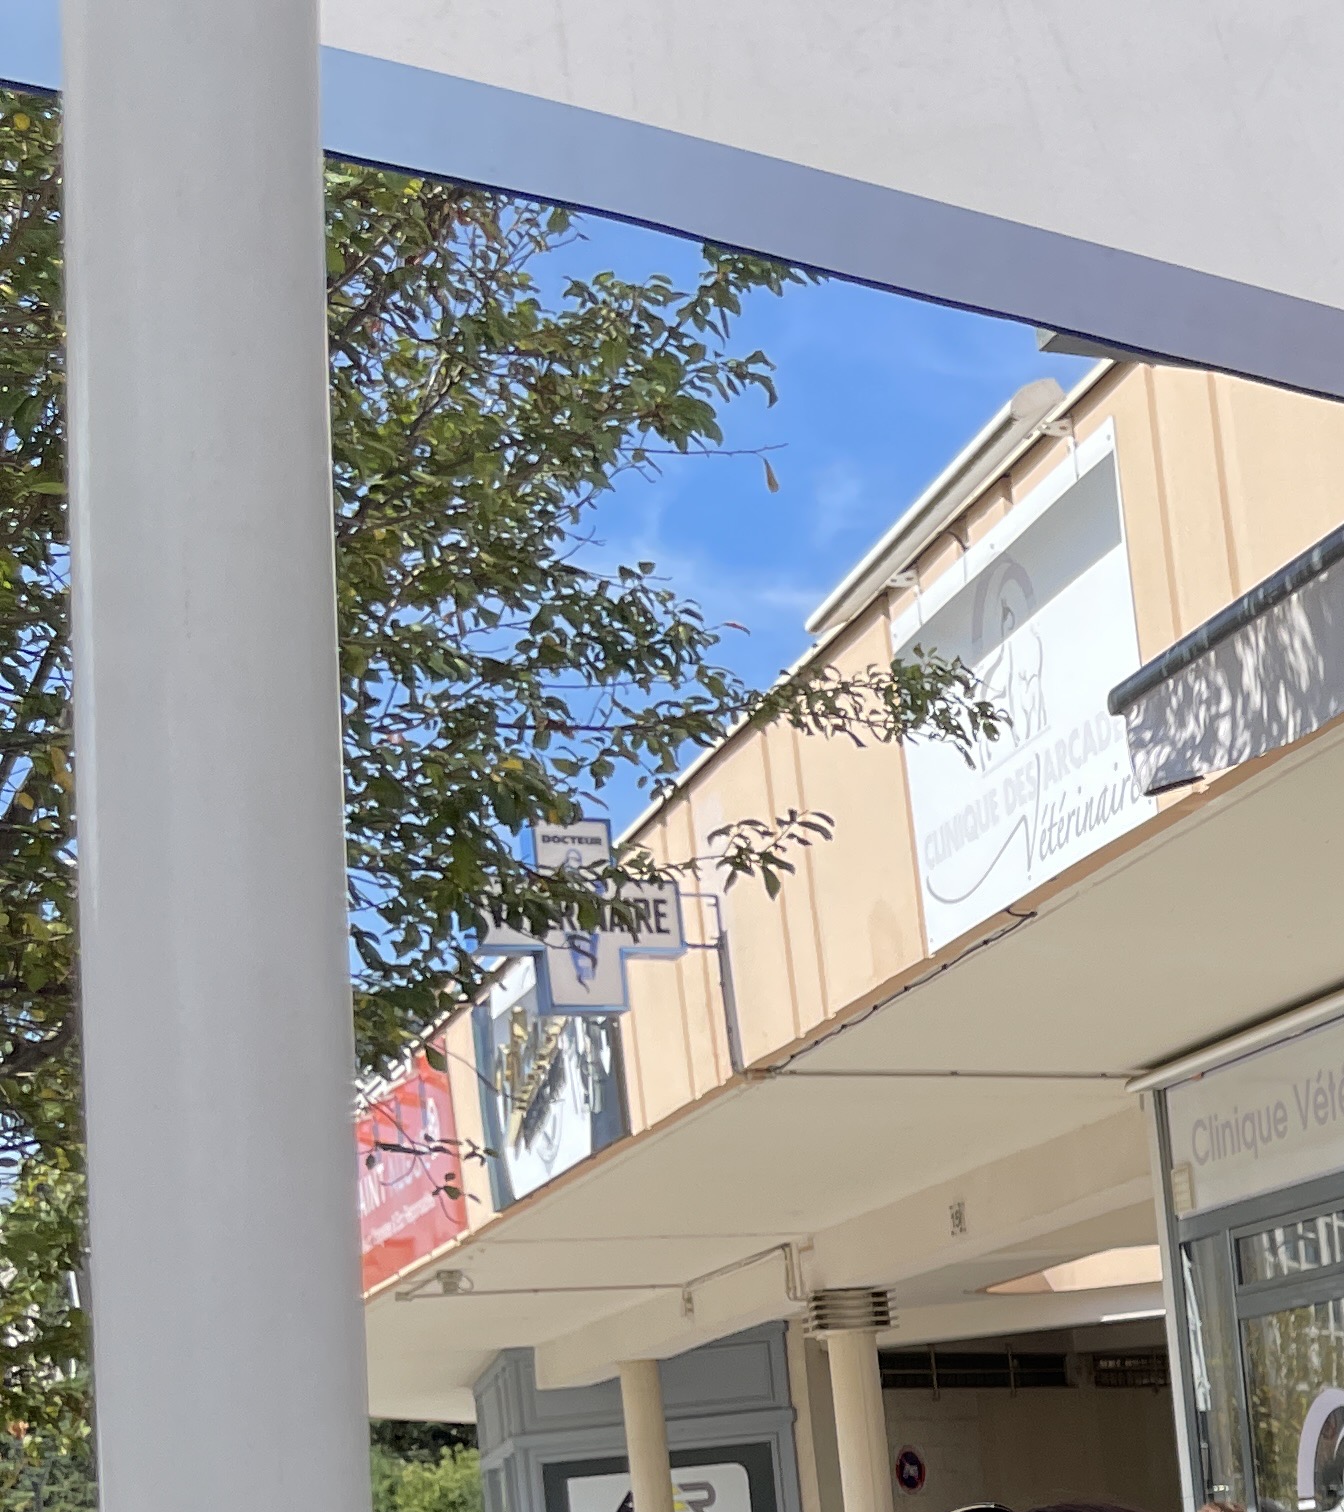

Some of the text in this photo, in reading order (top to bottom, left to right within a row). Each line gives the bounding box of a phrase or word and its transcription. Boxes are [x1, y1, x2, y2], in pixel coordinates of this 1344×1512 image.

[542, 835, 602, 846] DOCTEUR
[923, 787, 1000, 870] CLINIQUE
[1002, 758, 1036, 816] DES
[1191, 1100, 1288, 1166] Clinique
